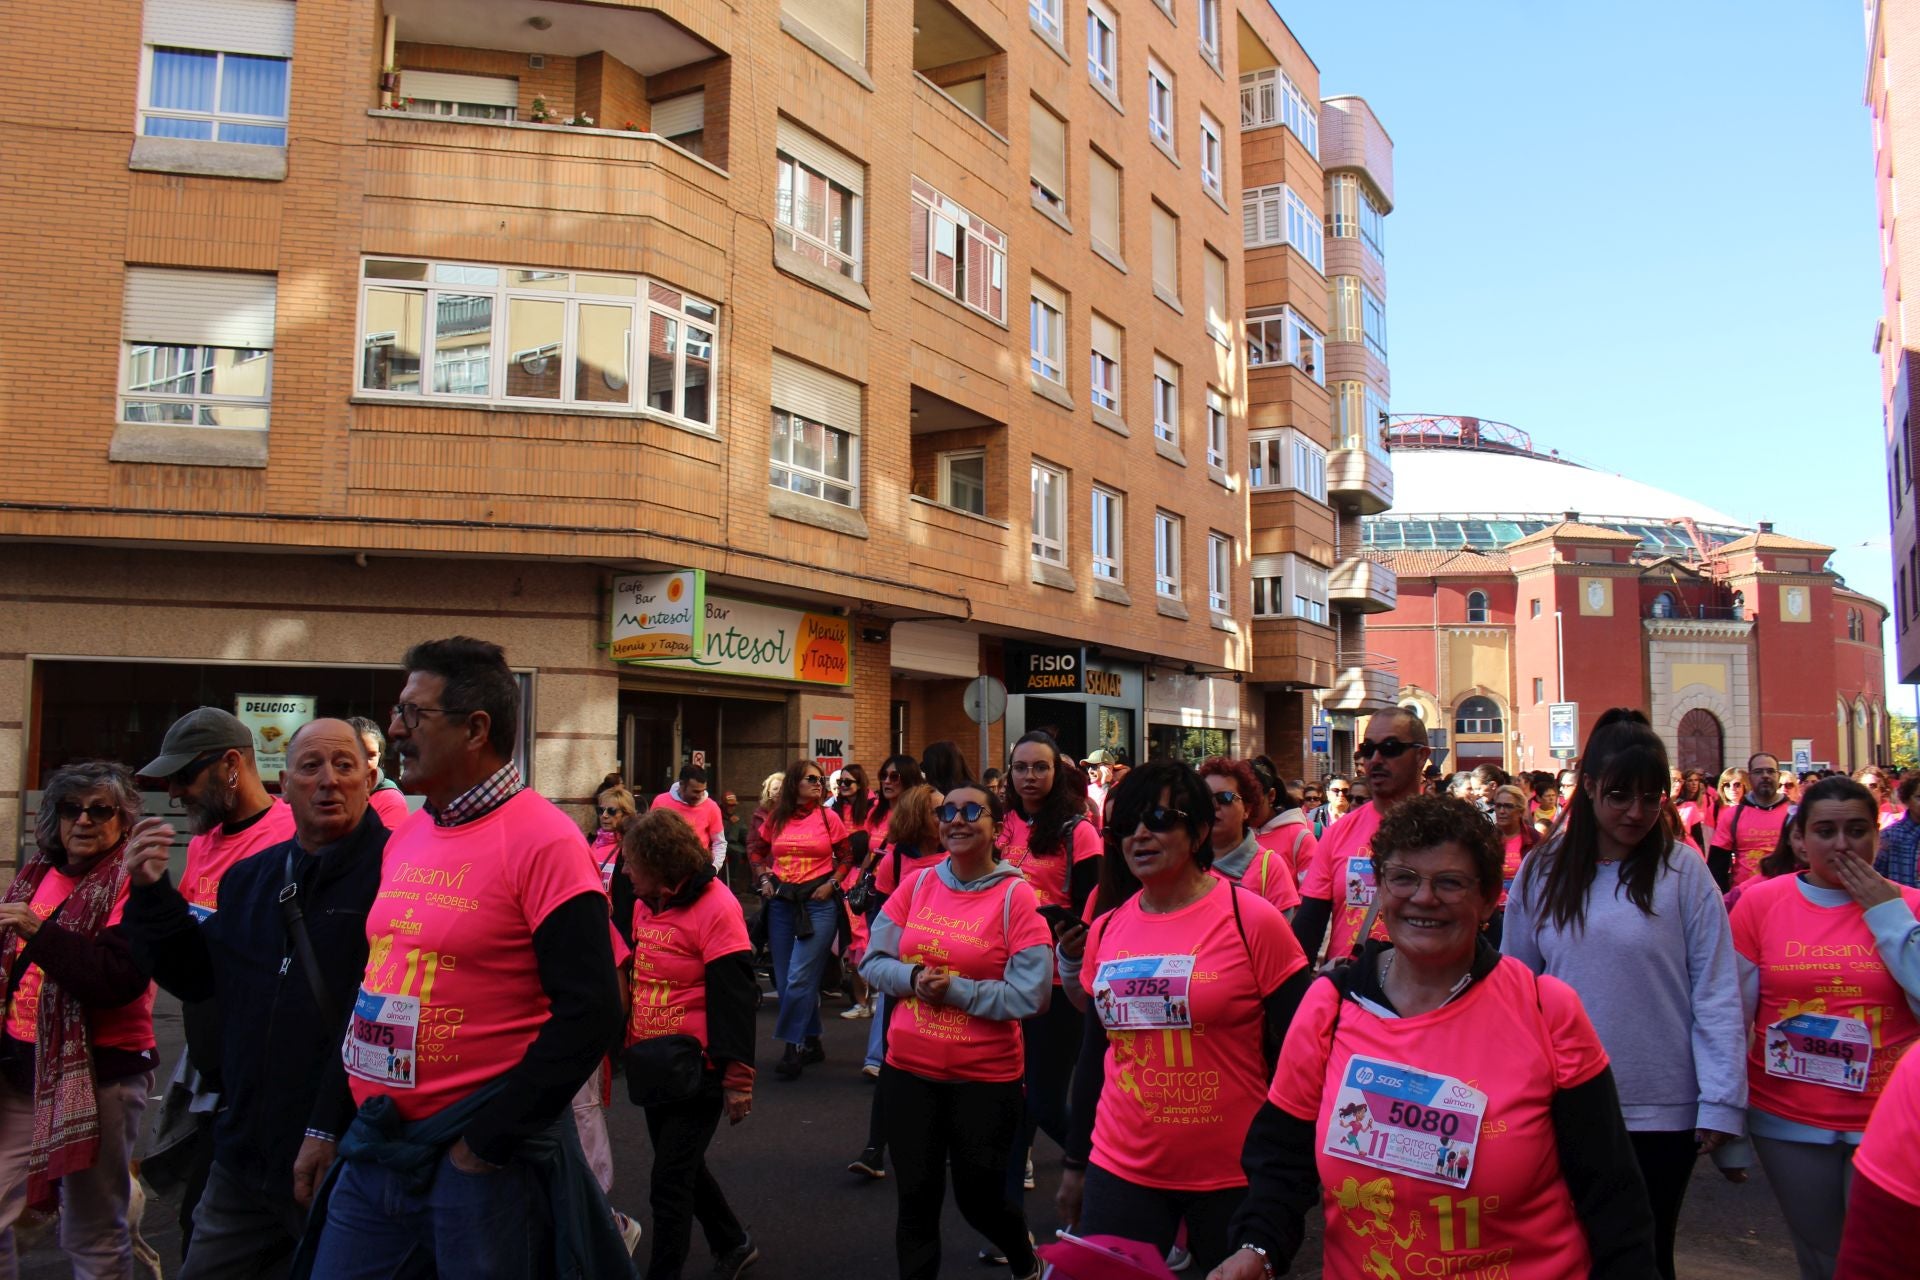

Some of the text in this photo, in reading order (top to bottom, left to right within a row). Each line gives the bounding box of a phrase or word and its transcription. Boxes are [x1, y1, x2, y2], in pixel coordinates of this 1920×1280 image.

[618, 581, 643, 593] Café
[635, 594, 656, 605] Bar
[705, 603, 730, 620] Bar
[808, 618, 846, 643] Menús
[613, 639, 691, 655] Menús y Tapas
[695, 626, 791, 665] ntesol
[800, 649, 846, 674] y Tapas
[1030, 654, 1075, 671] FISIO
[1027, 674, 1075, 688] ASEMAR
[816, 738, 843, 756] WOK
[425, 892, 479, 910] CAROBELS
[390, 918, 422, 931] SUZUKI
[917, 943, 949, 957] SUZUKI
[1784, 940, 1876, 958] Drasanv
[1849, 961, 1888, 971] CARO
[1125, 979, 1170, 995] 3752
[637, 1004, 685, 1017] Carrera
[929, 1008, 972, 1027] Mujer
[644, 1015, 685, 1030] Mujer
[358, 1020, 394, 1046] 3375
[920, 1028, 972, 1041] DRASANVI
[1803, 1036, 1854, 1060] 3845
[1142, 1067, 1220, 1088] Carrera
[1357, 1067, 1374, 1085] hp
[1162, 1086, 1220, 1106] Mujer
[1163, 1104, 1198, 1114] almom
[1153, 1115, 1223, 1124] DRASANVI
[1388, 1101, 1459, 1137] 5080
[1396, 1133, 1437, 1152] Carrera
[1402, 1145, 1437, 1160] Mujer
[1405, 1248, 1513, 1277] Carrera
